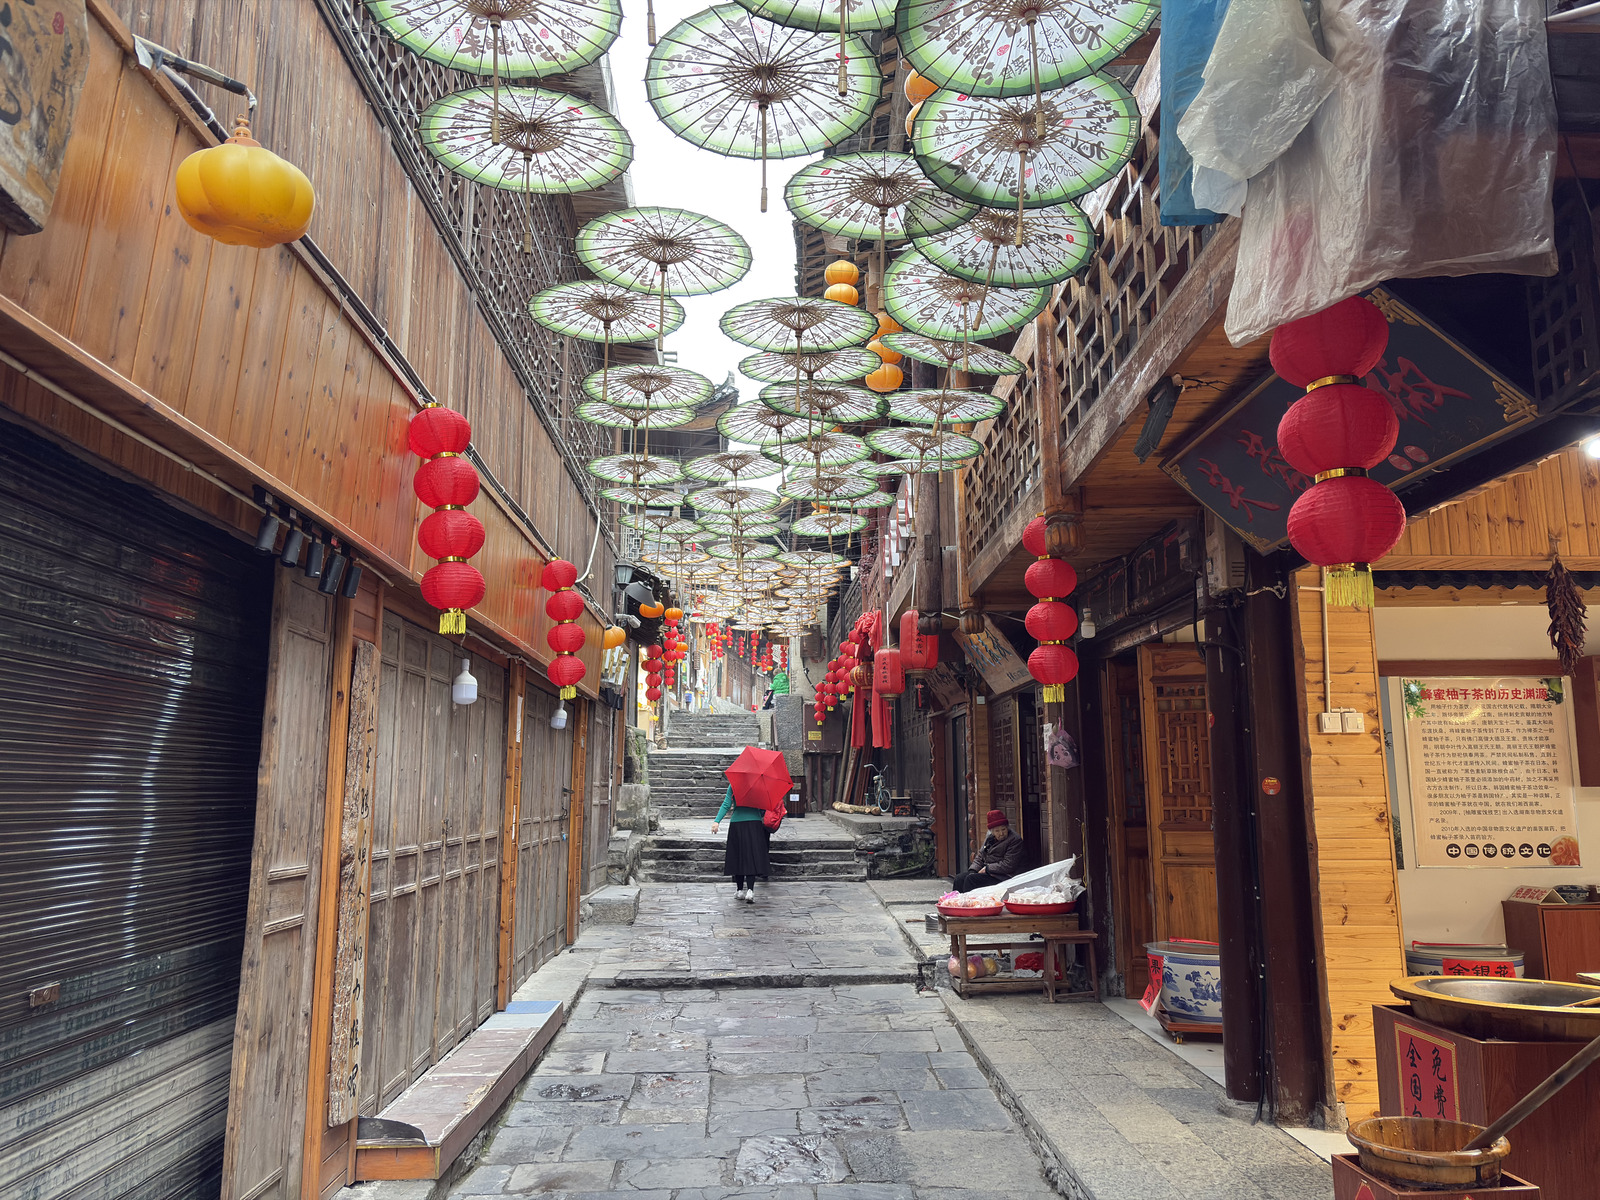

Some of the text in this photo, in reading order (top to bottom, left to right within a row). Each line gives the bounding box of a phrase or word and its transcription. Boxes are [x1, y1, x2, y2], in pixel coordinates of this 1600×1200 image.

[1420, 688, 1548, 700] 蜂蜜柚子茶的历史渊源
